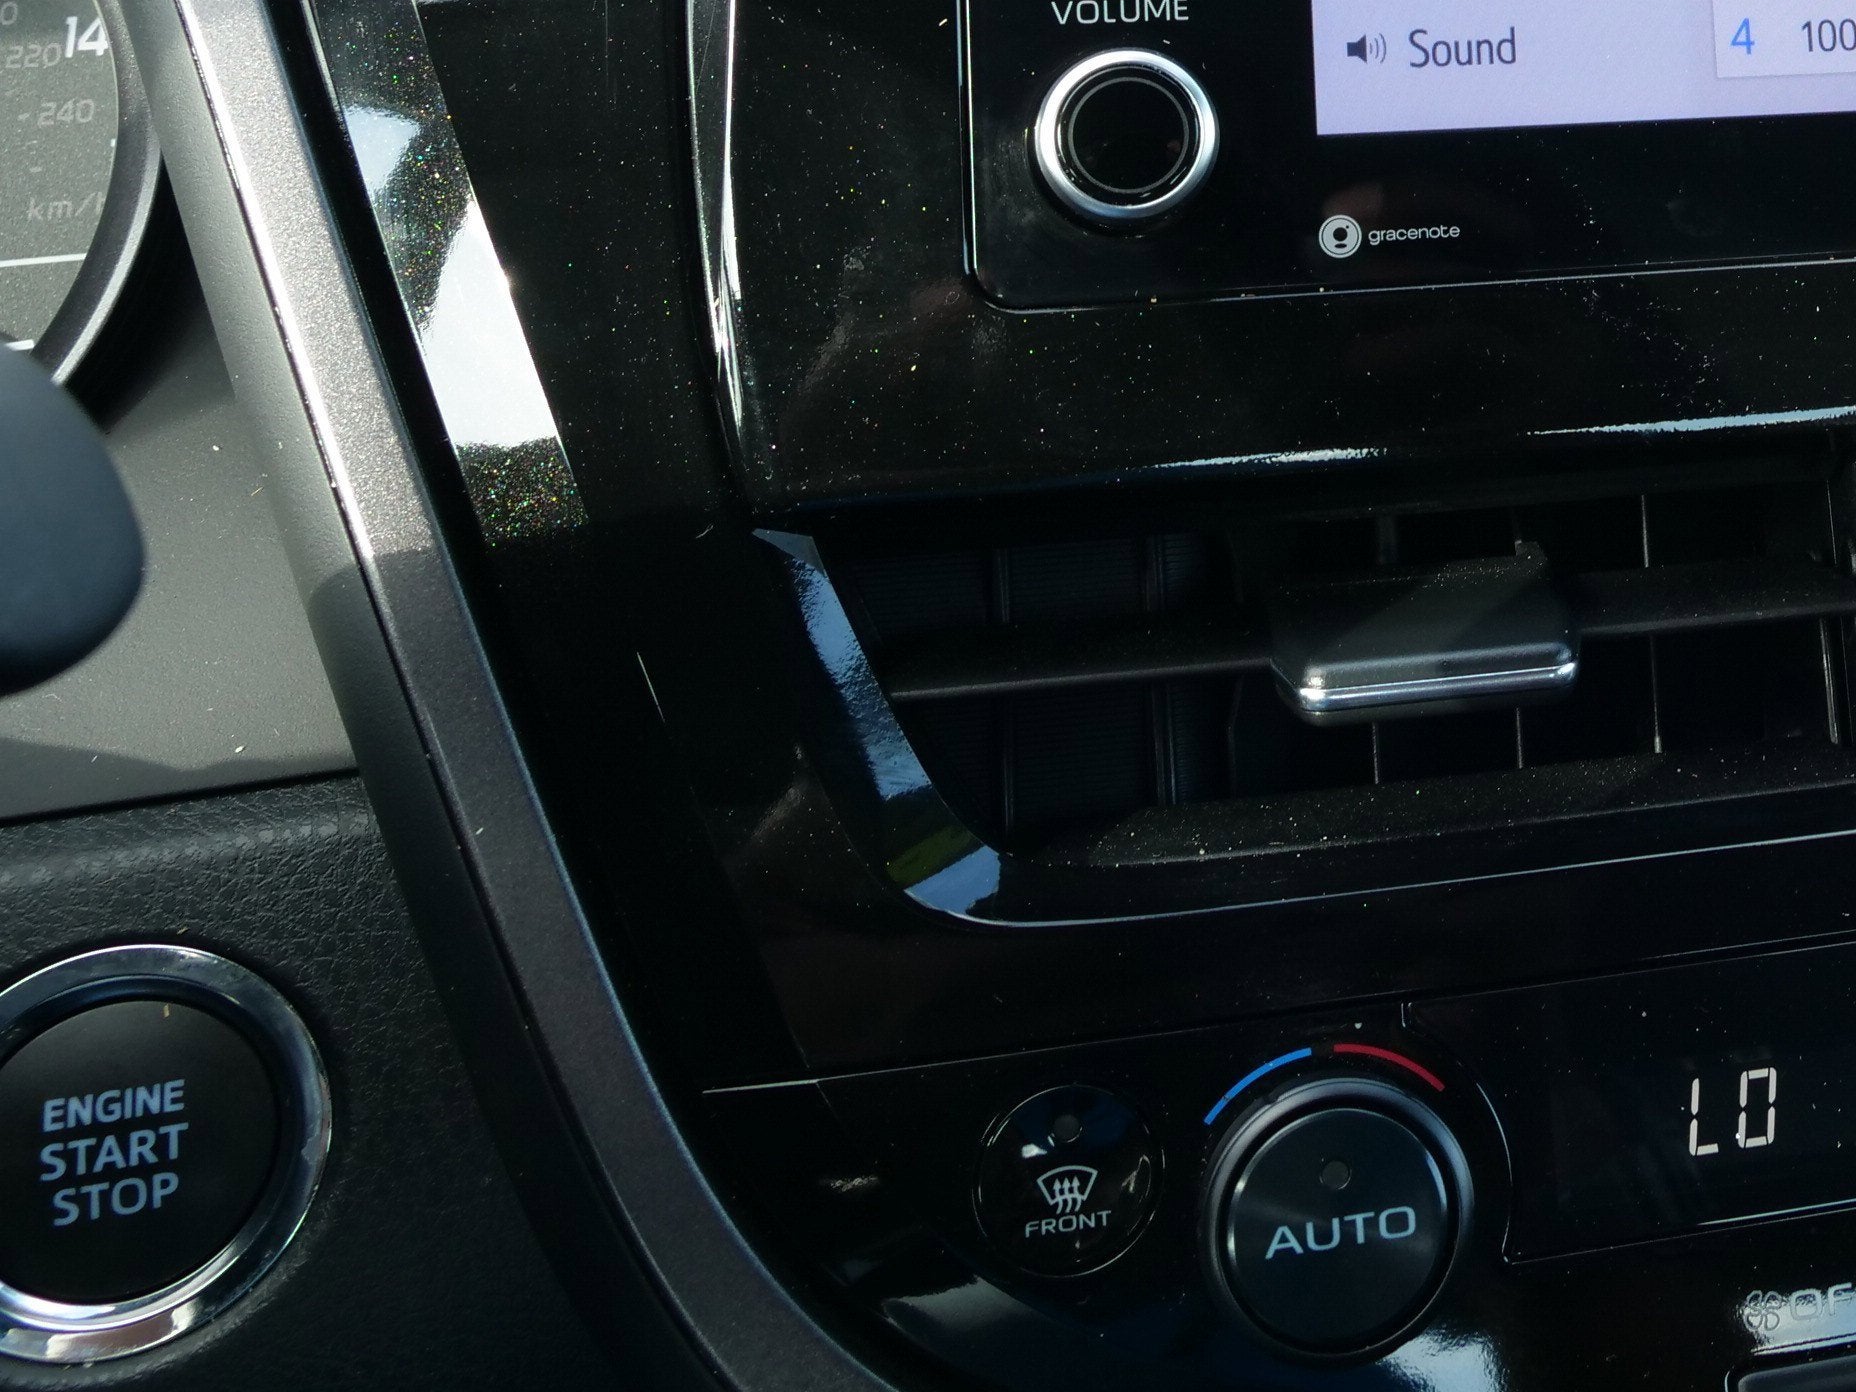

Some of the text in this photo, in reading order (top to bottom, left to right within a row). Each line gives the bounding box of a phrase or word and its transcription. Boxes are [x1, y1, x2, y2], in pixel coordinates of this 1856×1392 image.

[5, 43, 63, 69] 220
[65, 16, 109, 59] 14
[1408, 26, 1517, 68] Sound
[1730, 17, 1756, 55] 4
[37, 98, 96, 128] 240
[1368, 224, 1461, 246] gracenote
[41, 1079, 187, 1134] ENGINE
[1689, 1067, 1778, 1156] LO
[39, 1122, 190, 1183] START
[52, 1172, 180, 1228] STOP
[1024, 1209, 1113, 1239] FRONT
[1264, 1205, 1418, 1261] AUTO
